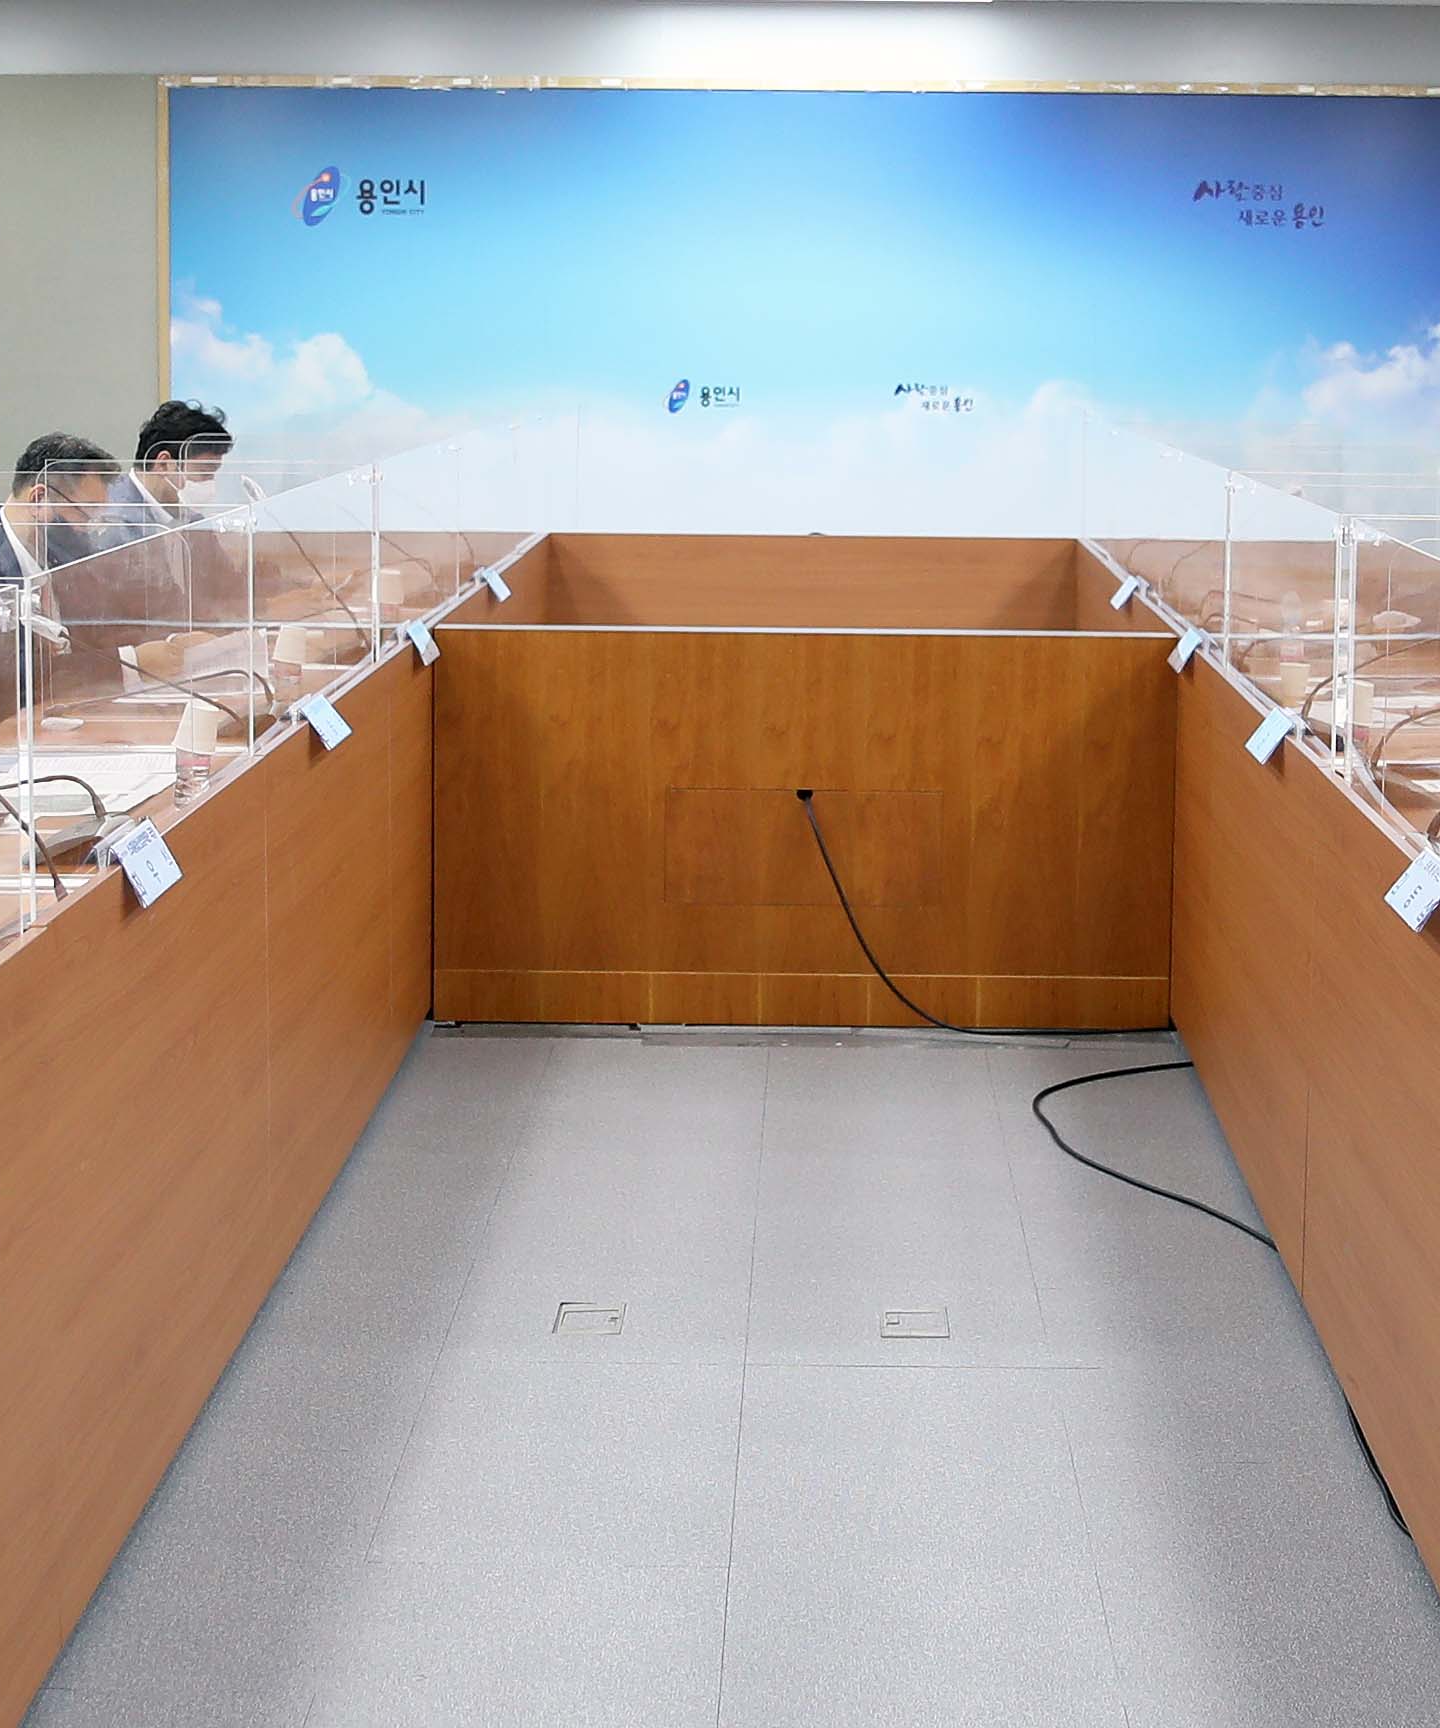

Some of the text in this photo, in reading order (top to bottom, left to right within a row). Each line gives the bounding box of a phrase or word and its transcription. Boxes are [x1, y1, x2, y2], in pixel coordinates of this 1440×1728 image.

[356, 179, 426, 215] 용인시
[1239, 203, 1325, 229] 새로운 용인
[700, 386, 740, 407] 용인시
